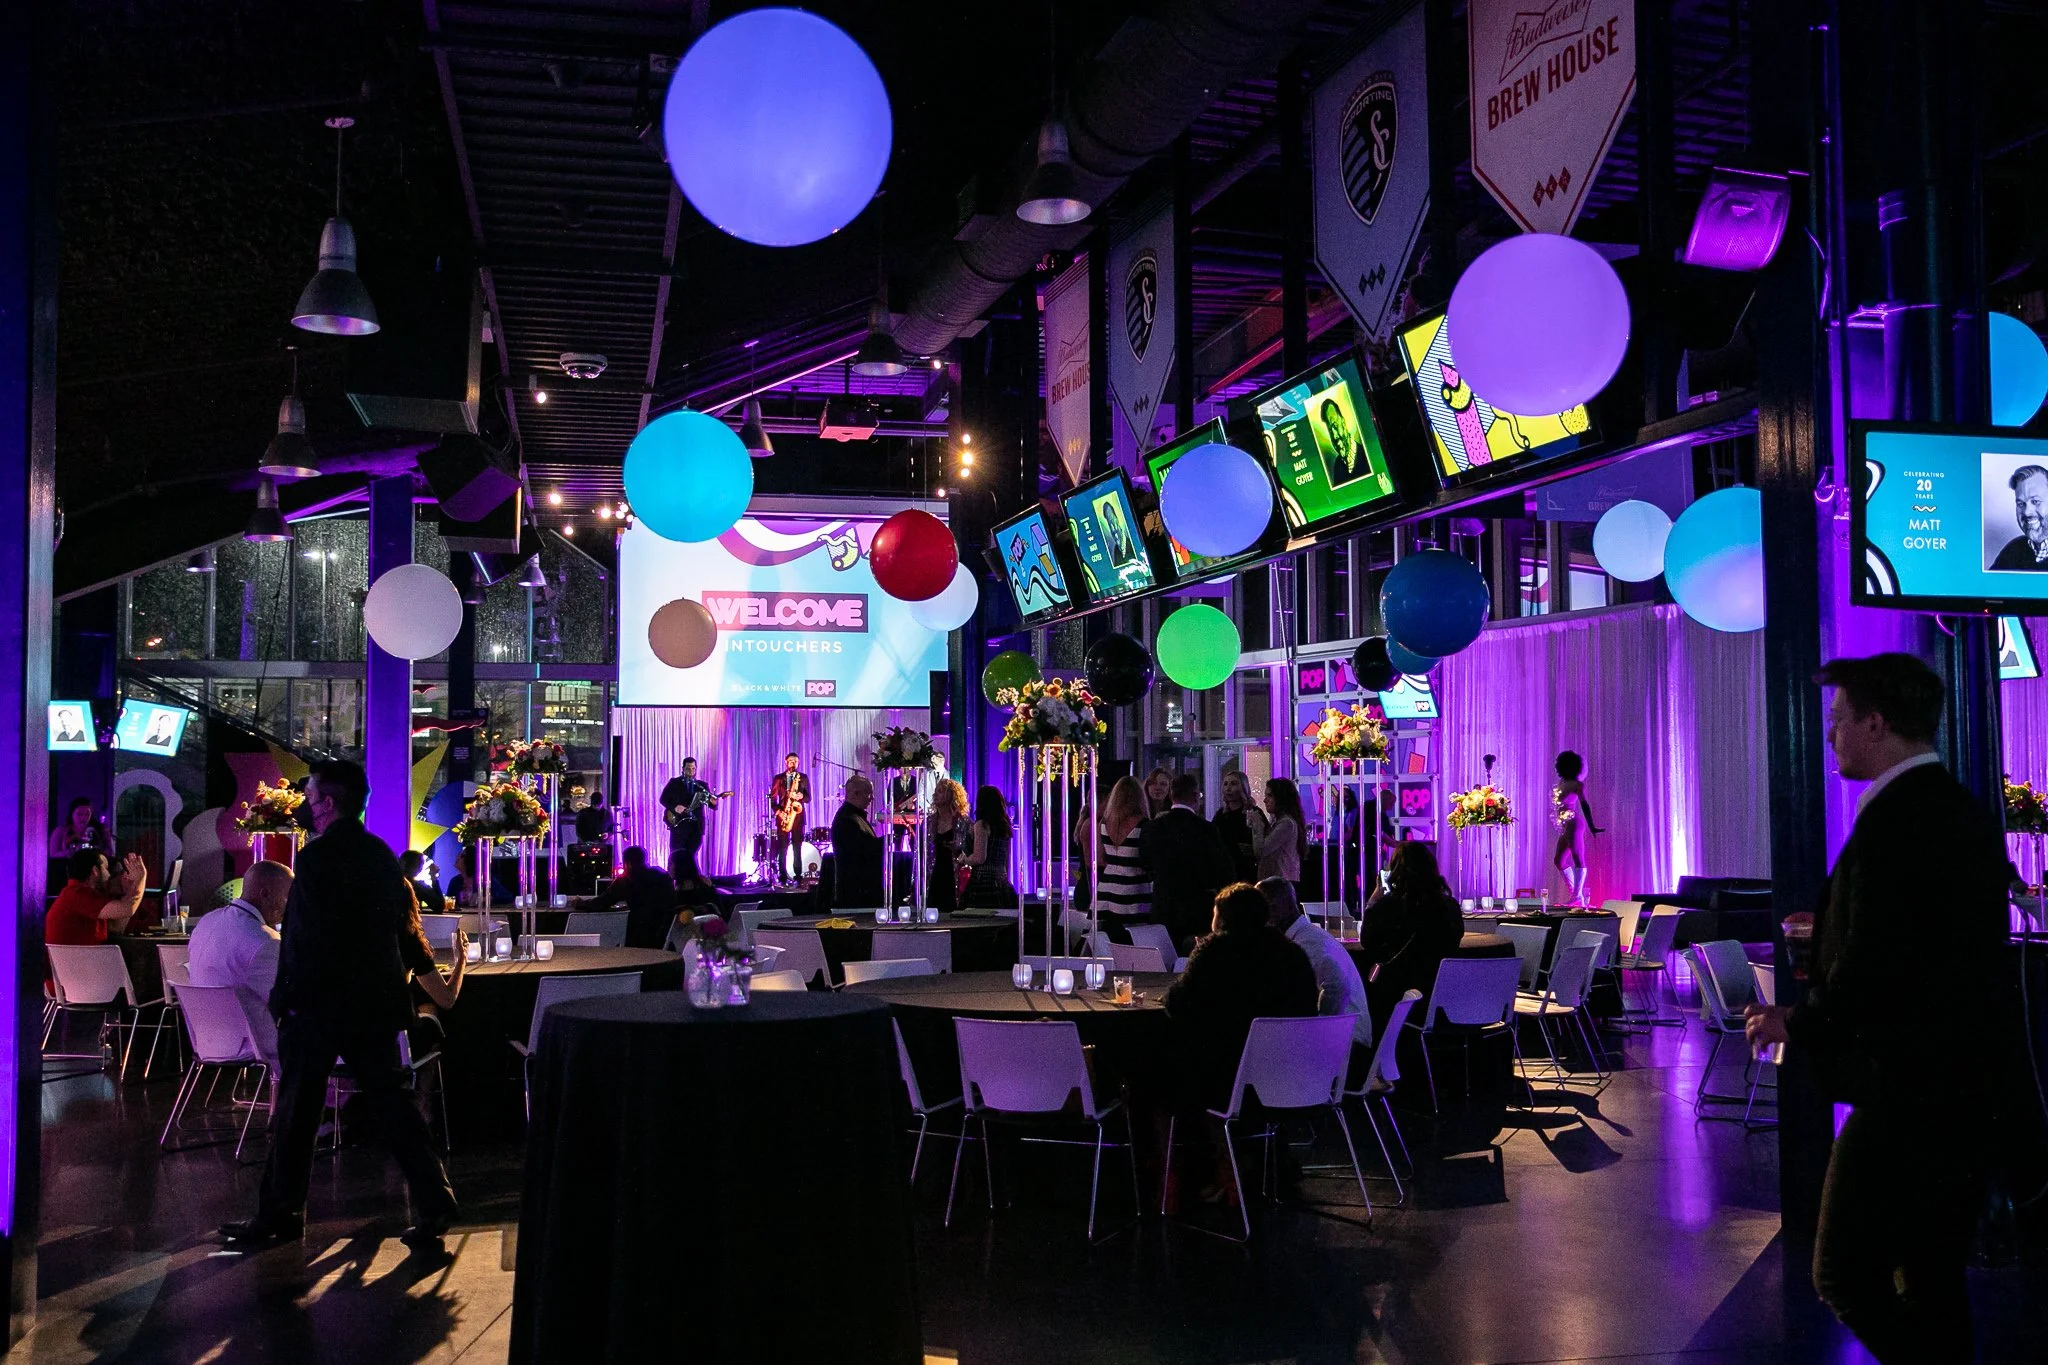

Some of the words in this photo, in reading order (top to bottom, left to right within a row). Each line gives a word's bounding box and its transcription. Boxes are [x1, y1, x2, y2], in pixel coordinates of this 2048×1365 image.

[1487, 66, 1541, 131] BREW
[1547, 16, 1619, 93] HOUSE
[1344, 90, 1393, 136] SPORTING
[1051, 376, 1071, 405] BREW
[1072, 362, 1090, 391] HOUS
[1903, 470, 1945, 478] CELEBRATING
[1916, 479, 1932, 491] 20
[1908, 519, 1941, 531] MATT
[1903, 536, 1947, 550] GOYER
[706, 597, 863, 627] WELCOME
[724, 639, 843, 653] INTOUCHERS
[1301, 668, 1325, 690] POP
[807, 682, 835, 695] POP
[1402, 789, 1431, 810] POP
